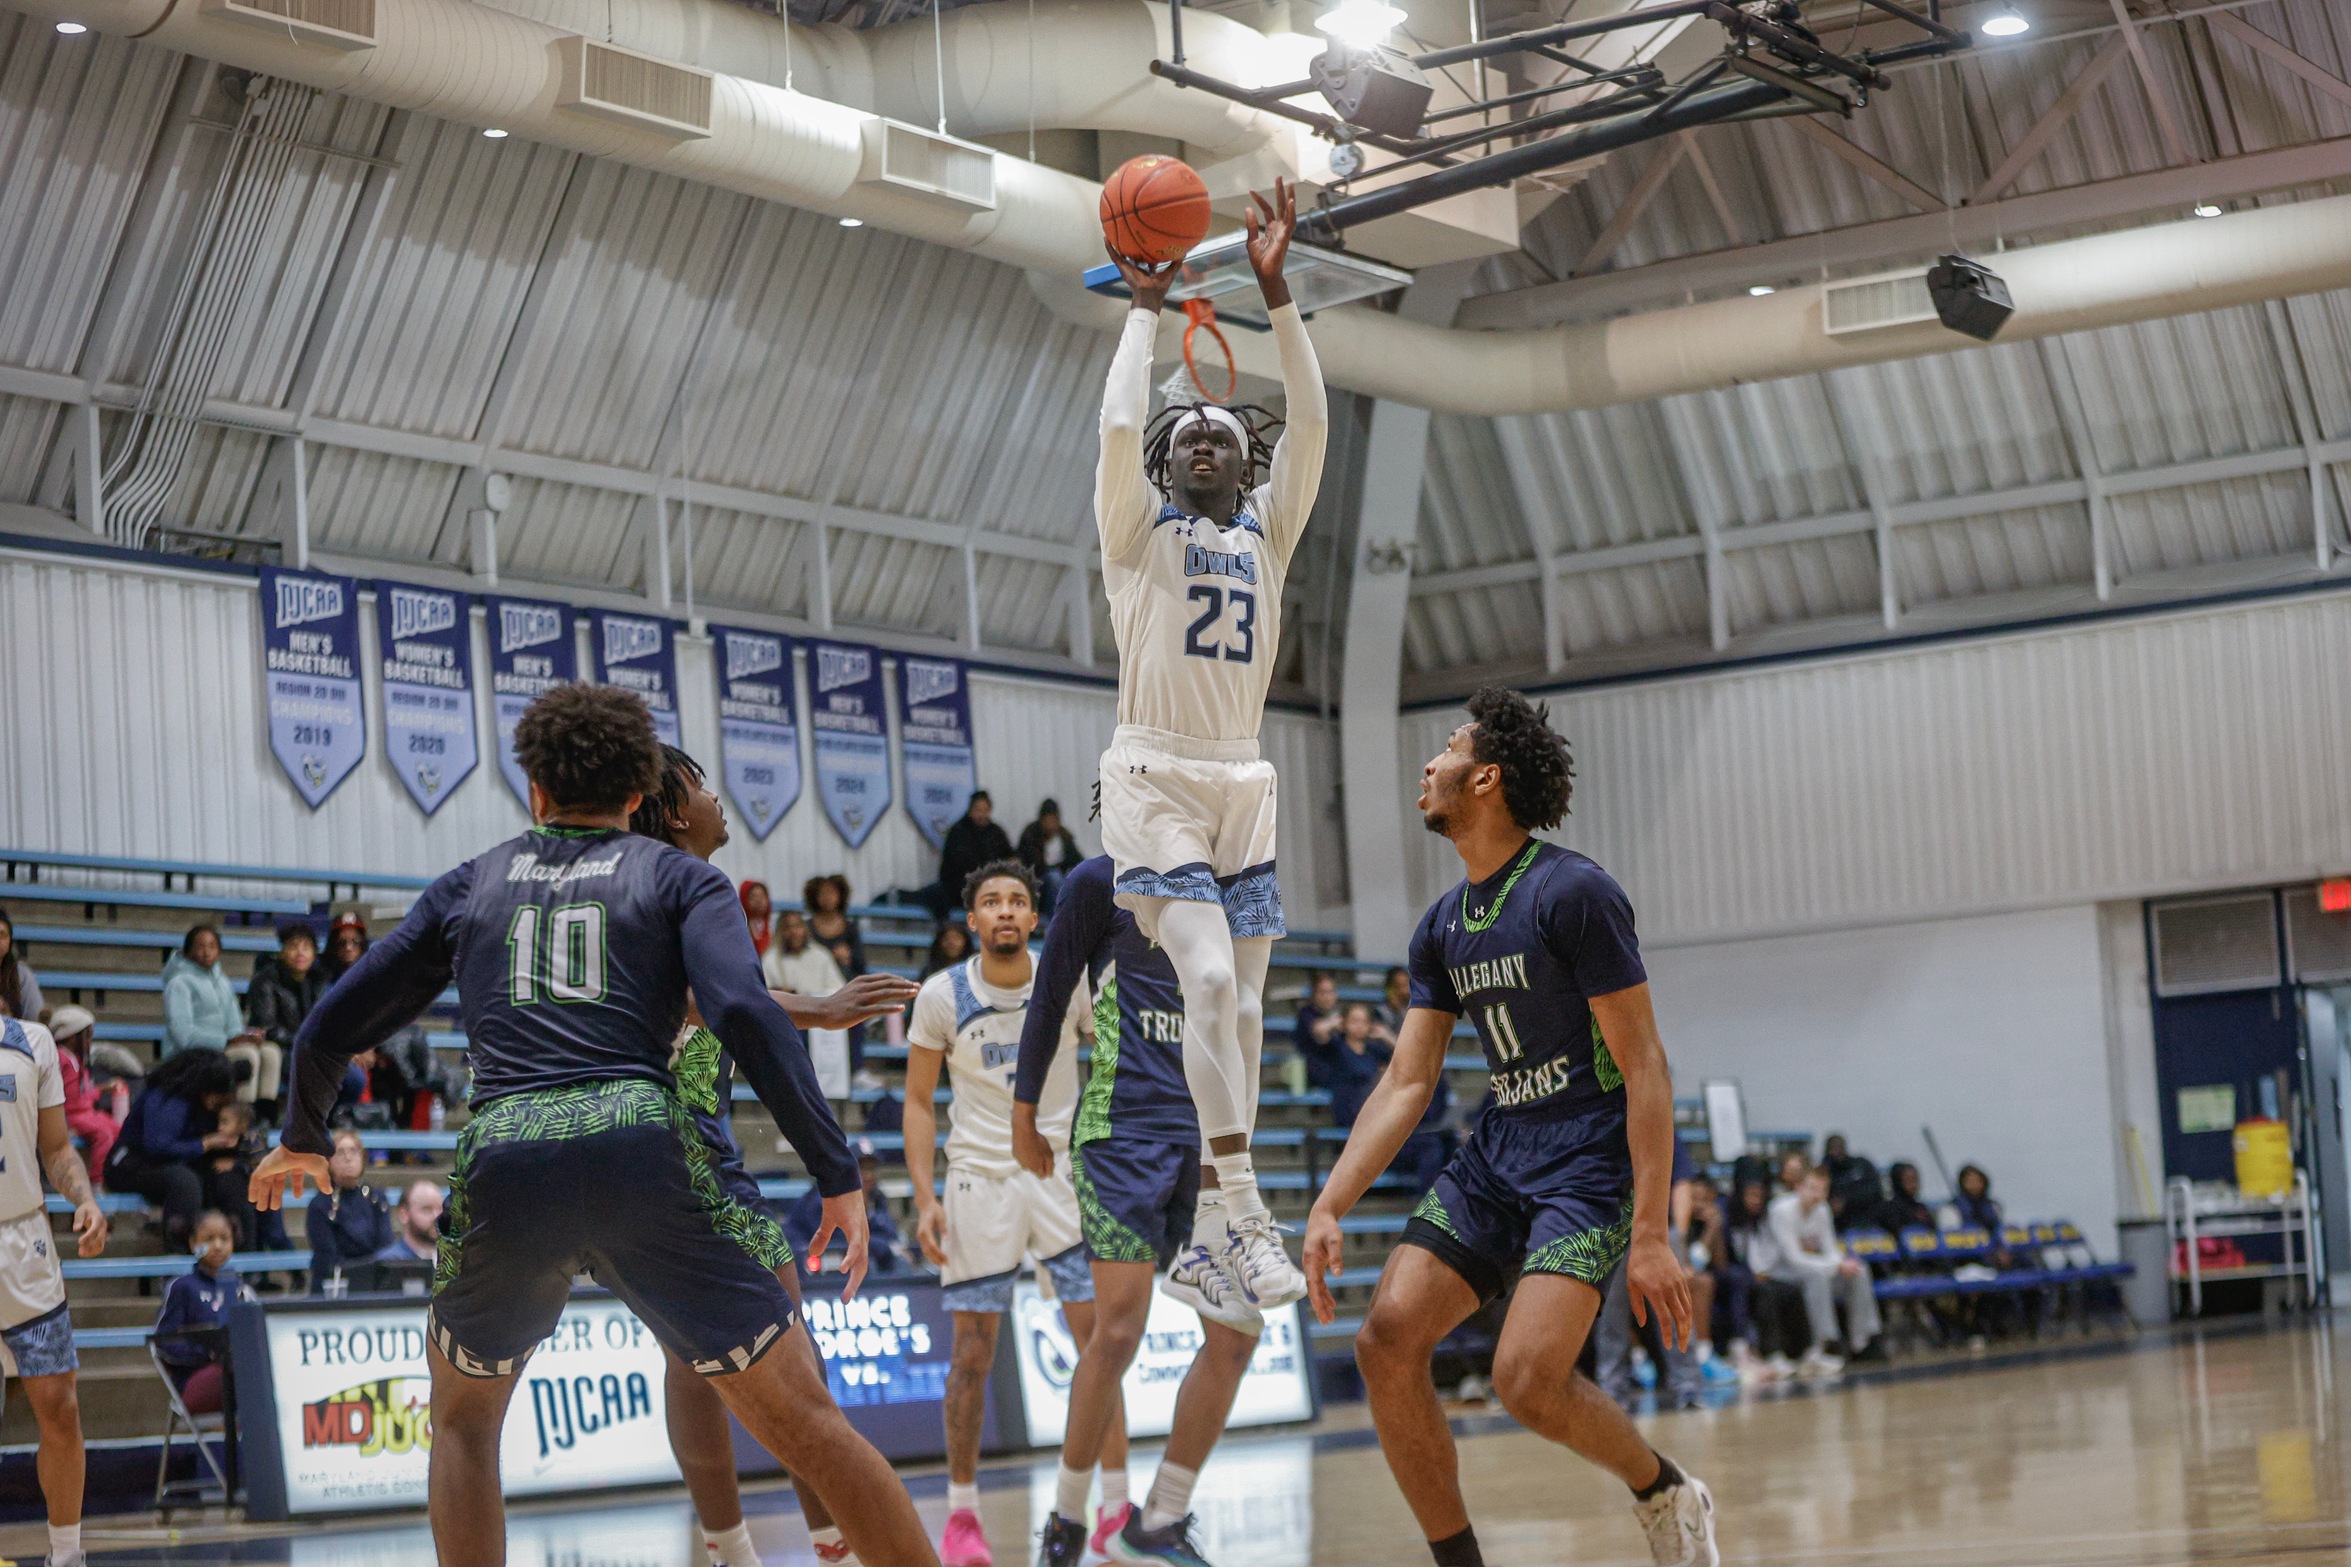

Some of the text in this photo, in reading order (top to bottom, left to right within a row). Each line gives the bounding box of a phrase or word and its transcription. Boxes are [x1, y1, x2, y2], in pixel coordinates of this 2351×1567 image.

[1184, 543, 1257, 585] OWLS
[278, 579, 340, 625] NJCAA
[393, 591, 453, 636] NJCAA
[288, 630, 333, 656] MEN'S
[1184, 584, 1256, 665] 23
[267, 648, 353, 678] BASKETBALL
[383, 657, 464, 688] BASKETBALL
[394, 641, 455, 668] WOMEN'S
[294, 724, 332, 747] 2019
[507, 852, 624, 891] Maryland
[506, 900, 608, 1007] 10
[1484, 1002, 1524, 1064] 11
[1491, 1055, 1570, 1107] OJANS
[298, 1325, 424, 1366] PROUD
[813, 1323, 931, 1360] ORGE'S
[303, 1400, 432, 1457] MDJUC
[529, 1370, 651, 1459] NJCAA
